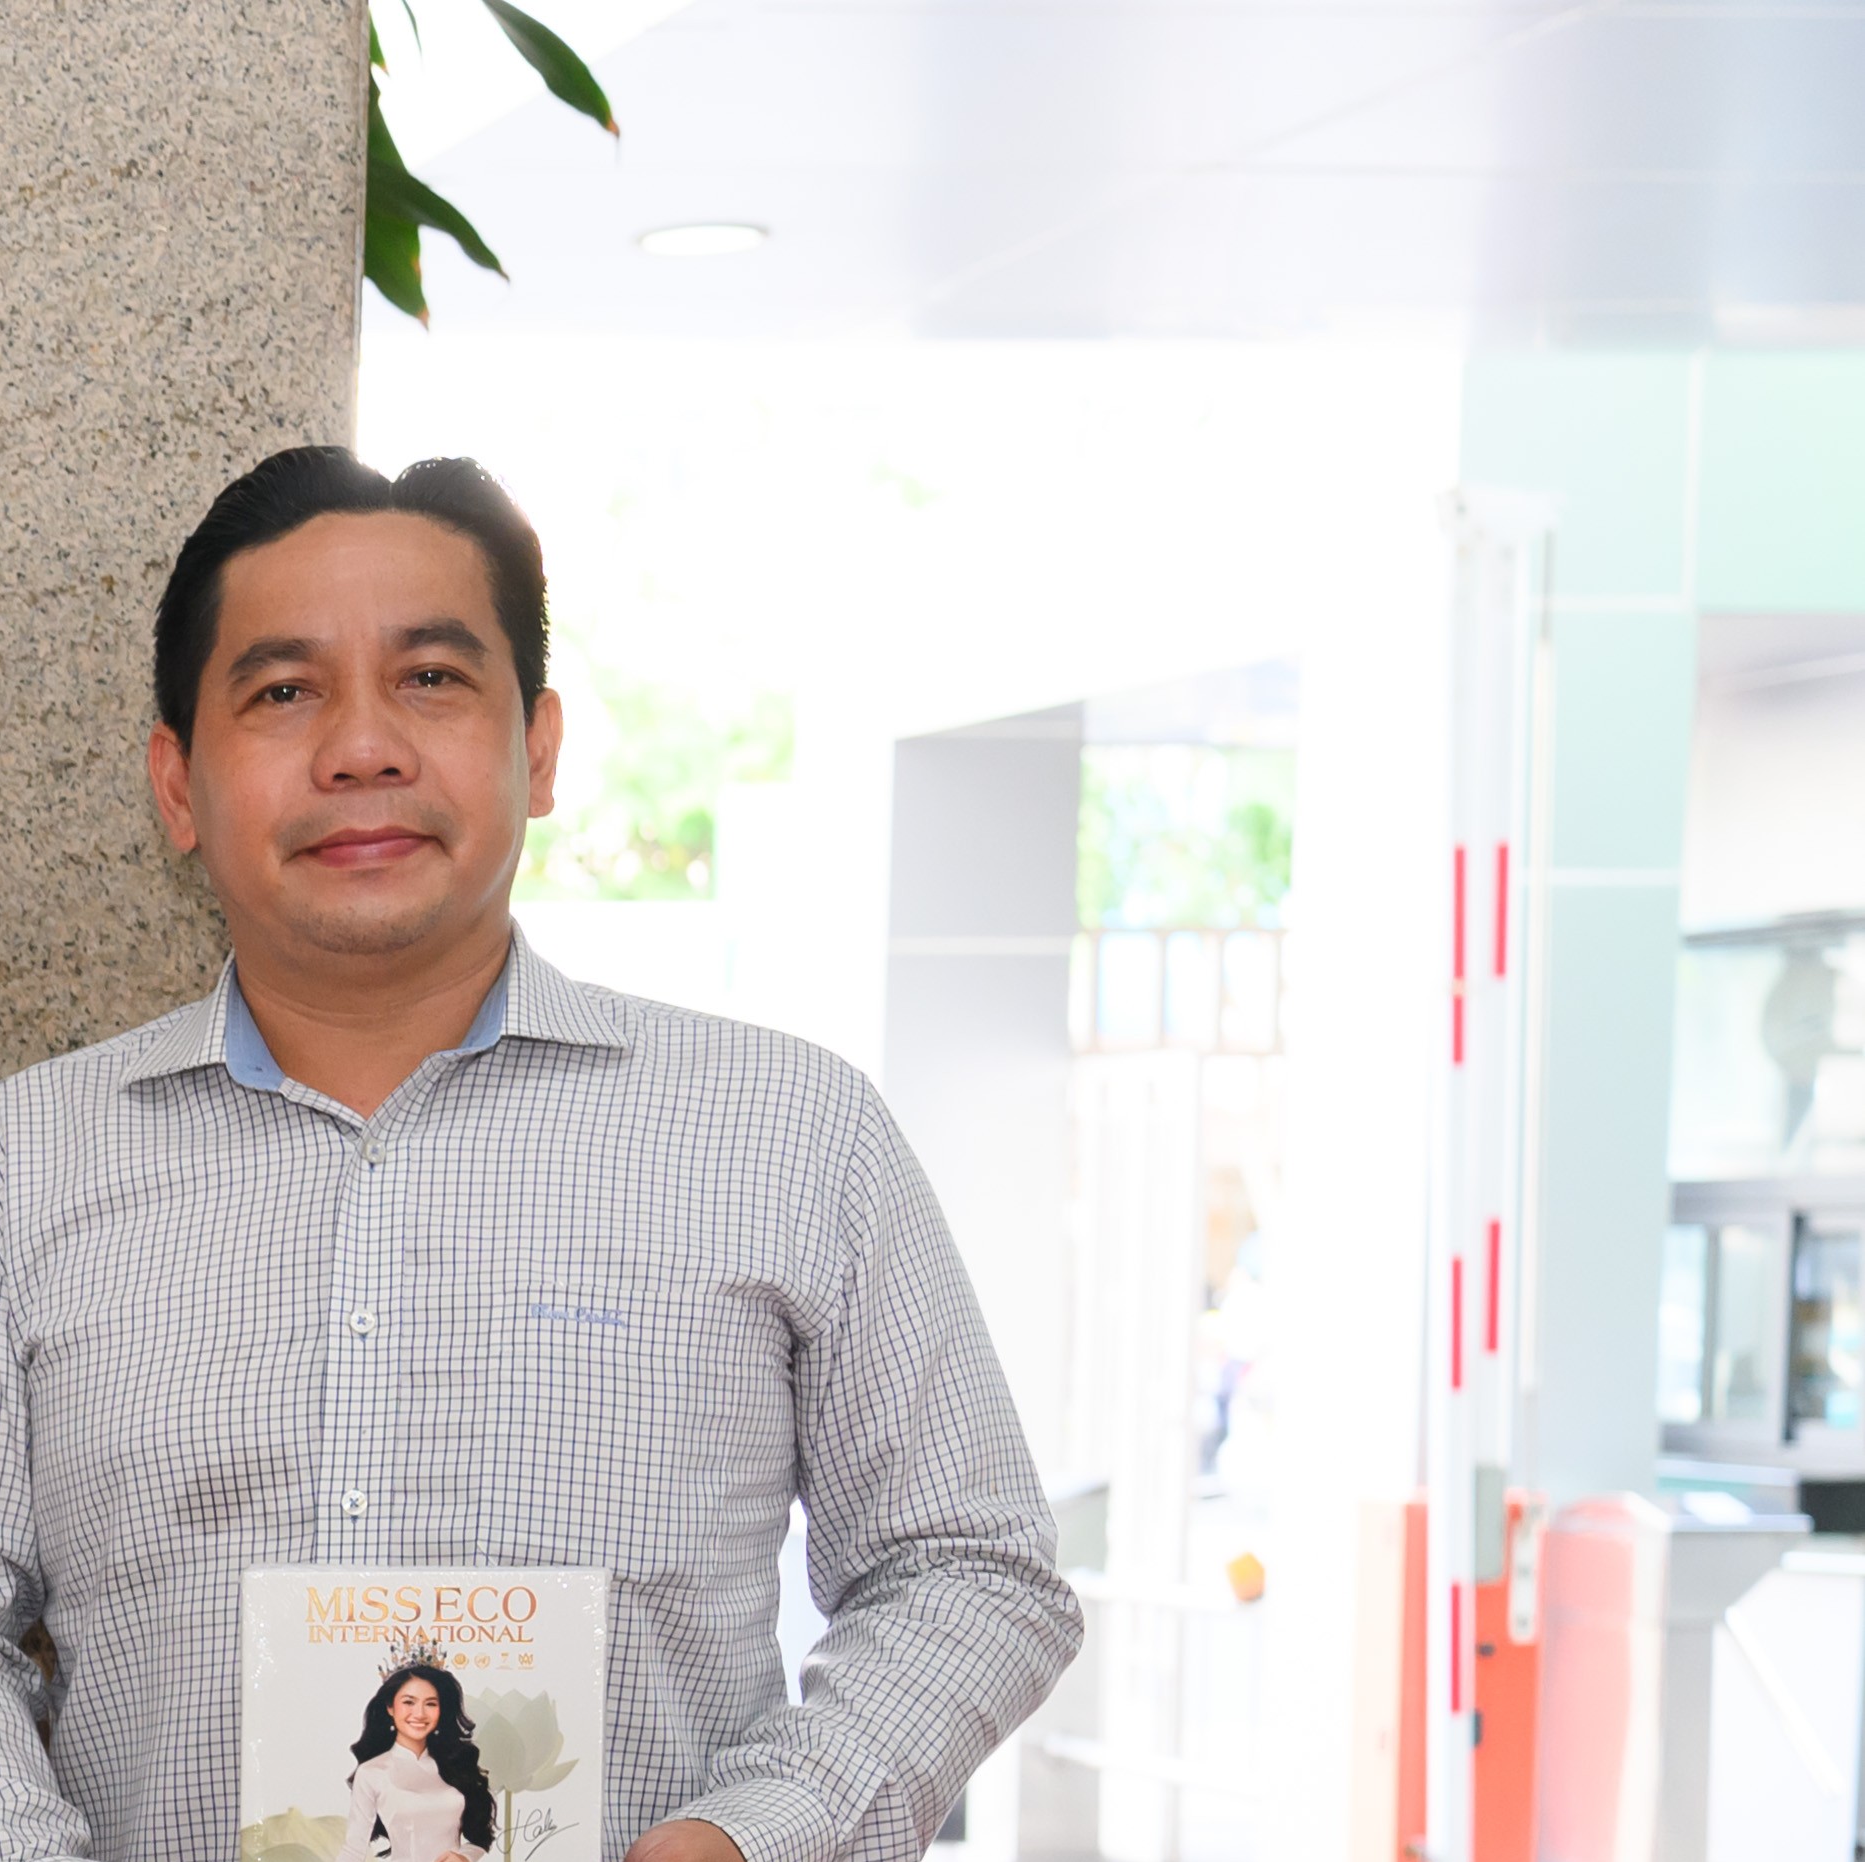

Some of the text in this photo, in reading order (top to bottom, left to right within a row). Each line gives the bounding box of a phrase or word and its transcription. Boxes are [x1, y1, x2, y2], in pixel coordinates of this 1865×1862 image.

[304, 1586, 537, 1623] MISS ECO
[307, 1624, 535, 1644] INTERNATIONAL
